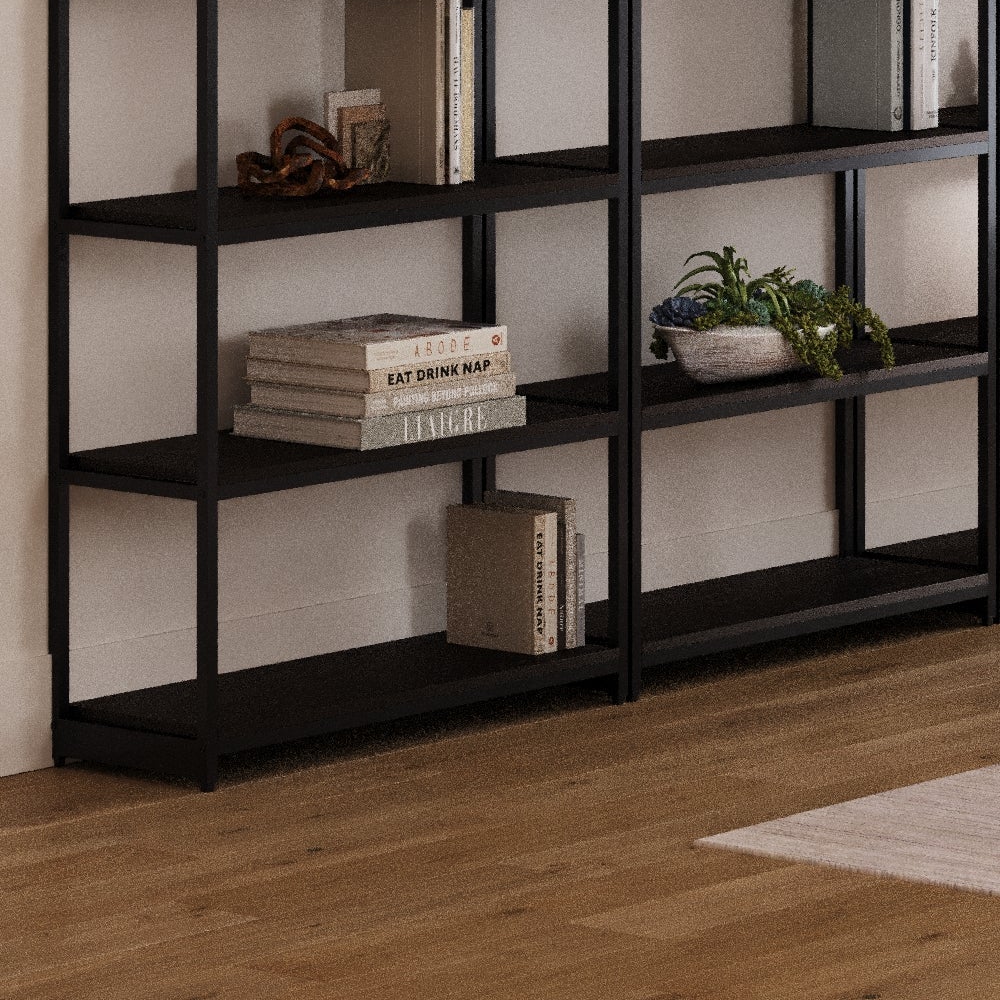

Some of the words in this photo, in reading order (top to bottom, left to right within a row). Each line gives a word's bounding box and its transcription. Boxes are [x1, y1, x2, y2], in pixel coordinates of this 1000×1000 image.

[414, 336, 471, 358] ABODE
[387, 370, 413, 386] EAT
[416, 364, 459, 382] DRINK
[462, 359, 491, 375] NAP
[404, 405, 487, 442] LIAIGRE
